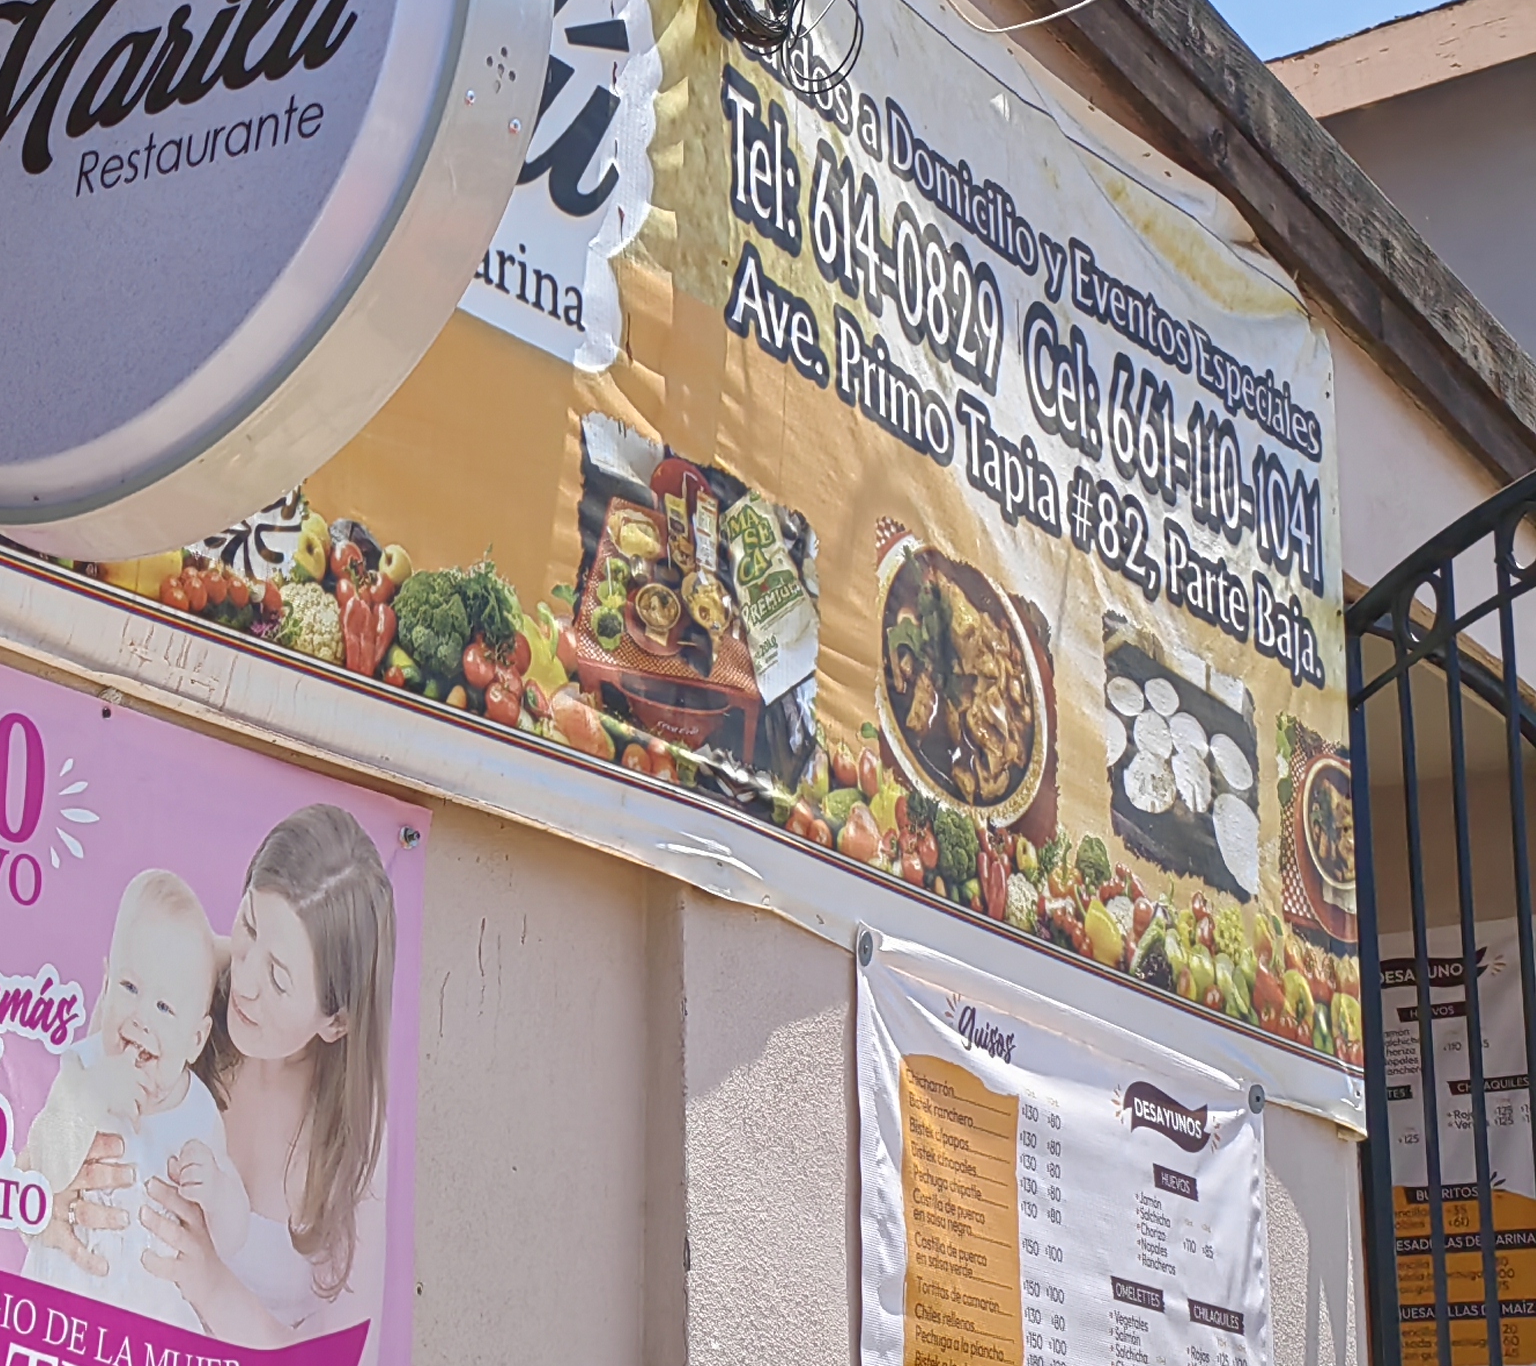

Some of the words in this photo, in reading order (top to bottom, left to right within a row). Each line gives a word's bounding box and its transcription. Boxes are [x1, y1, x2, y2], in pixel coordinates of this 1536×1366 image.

[76, 95, 324, 197] Restaurante
[860, 98, 881, 157] a
[889, 101, 1036, 271] Domicilio
[1040, 237, 1064, 297] y
[1071, 241, 1191, 369] Eventos
[1194, 325, 1320, 457] Especiales
[726, 78, 799, 250] Tel:
[813, 145, 1001, 388] 614-0829
[1026, 308, 1100, 454] Cel:
[1111, 361, 1322, 589] 661-110-1041
[729, 250, 826, 383] Ave.
[837, 308, 952, 462] Primo
[958, 396, 1061, 530] Tapia
[1070, 473, 1160, 593] #82,
[1167, 516, 1247, 637] Parte
[1255, 574, 1324, 682] Baja.
[1133, 1096, 1203, 1139] DESAYUNOS
[1161, 1172, 1191, 1194] HUEVOS
[1115, 1283, 1160, 1307] OMELETTES
[1193, 1305, 1239, 1330] CHILAQUILES
[43, 1308, 87, 1354] DE
